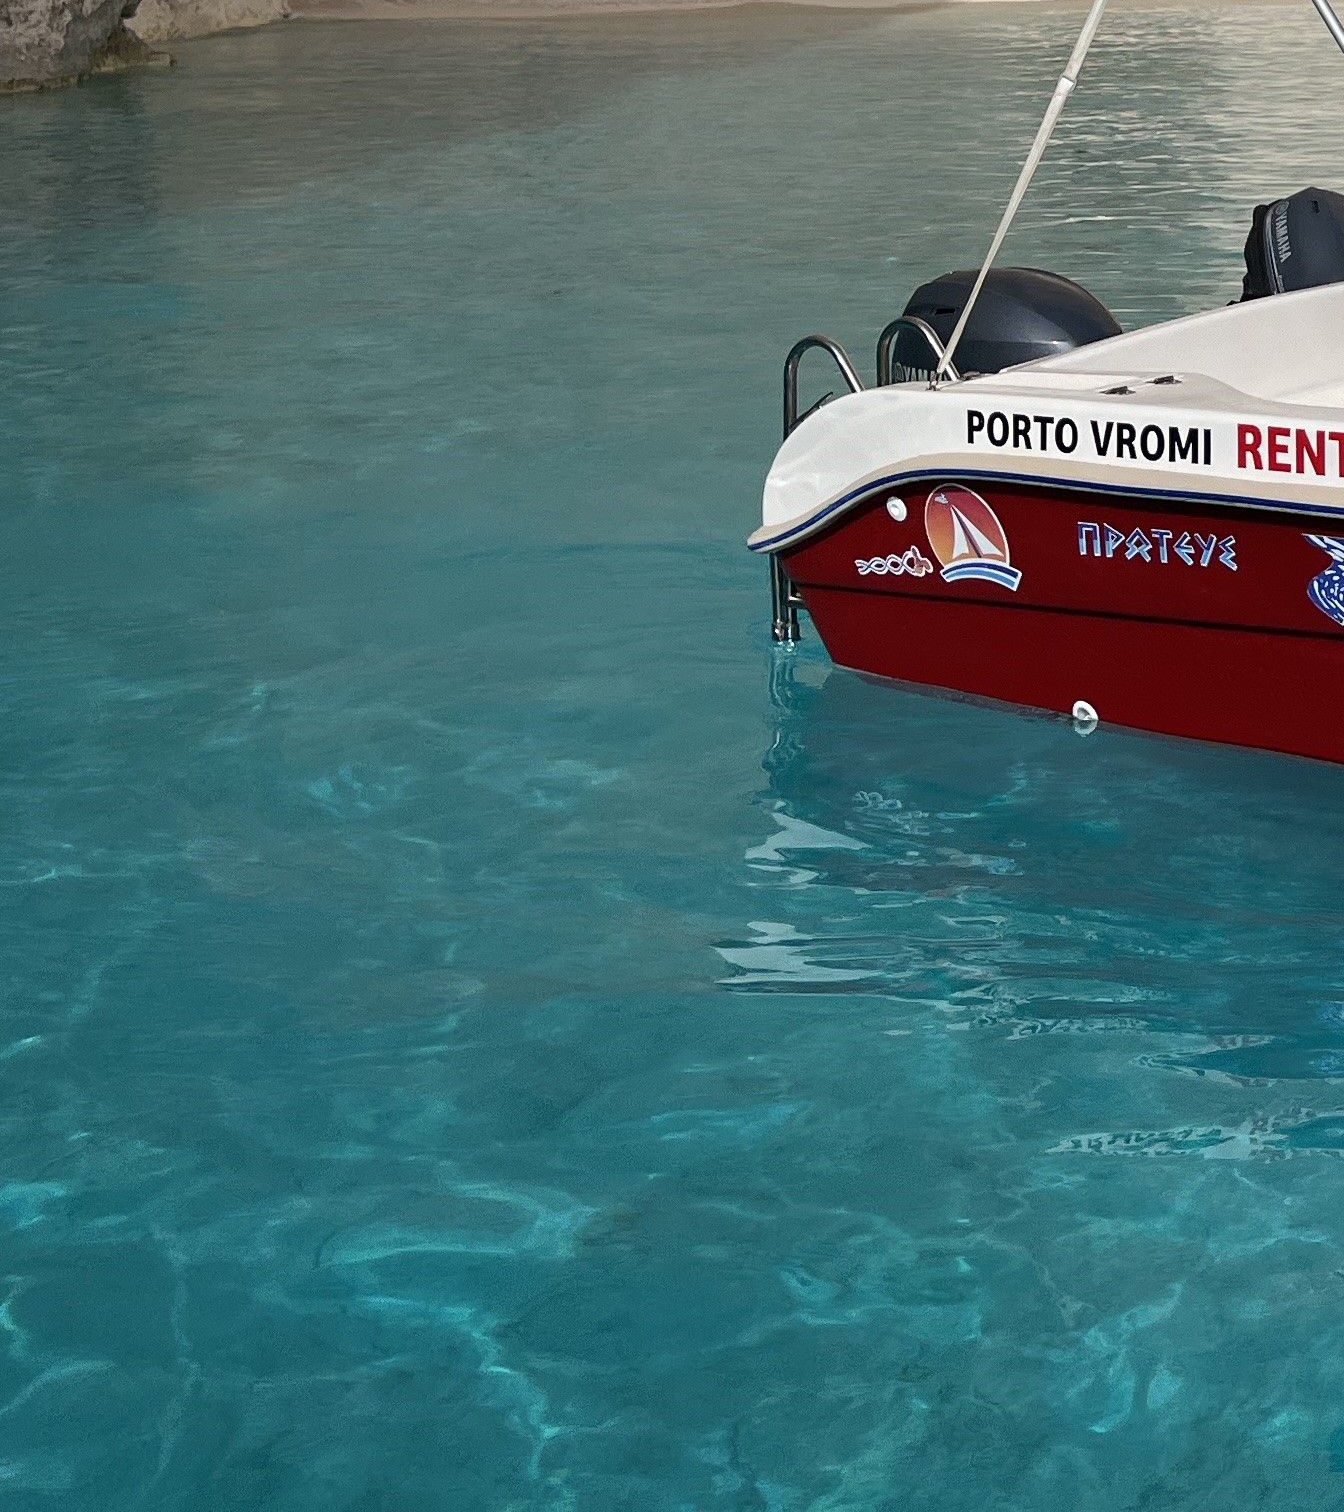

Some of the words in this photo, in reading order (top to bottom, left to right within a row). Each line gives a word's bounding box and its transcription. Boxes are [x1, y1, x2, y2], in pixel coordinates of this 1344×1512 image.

[1275, 211, 1291, 263] YAMAHA
[966, 409, 1079, 454] PORTO
[1089, 419, 1212, 466] VROMI
